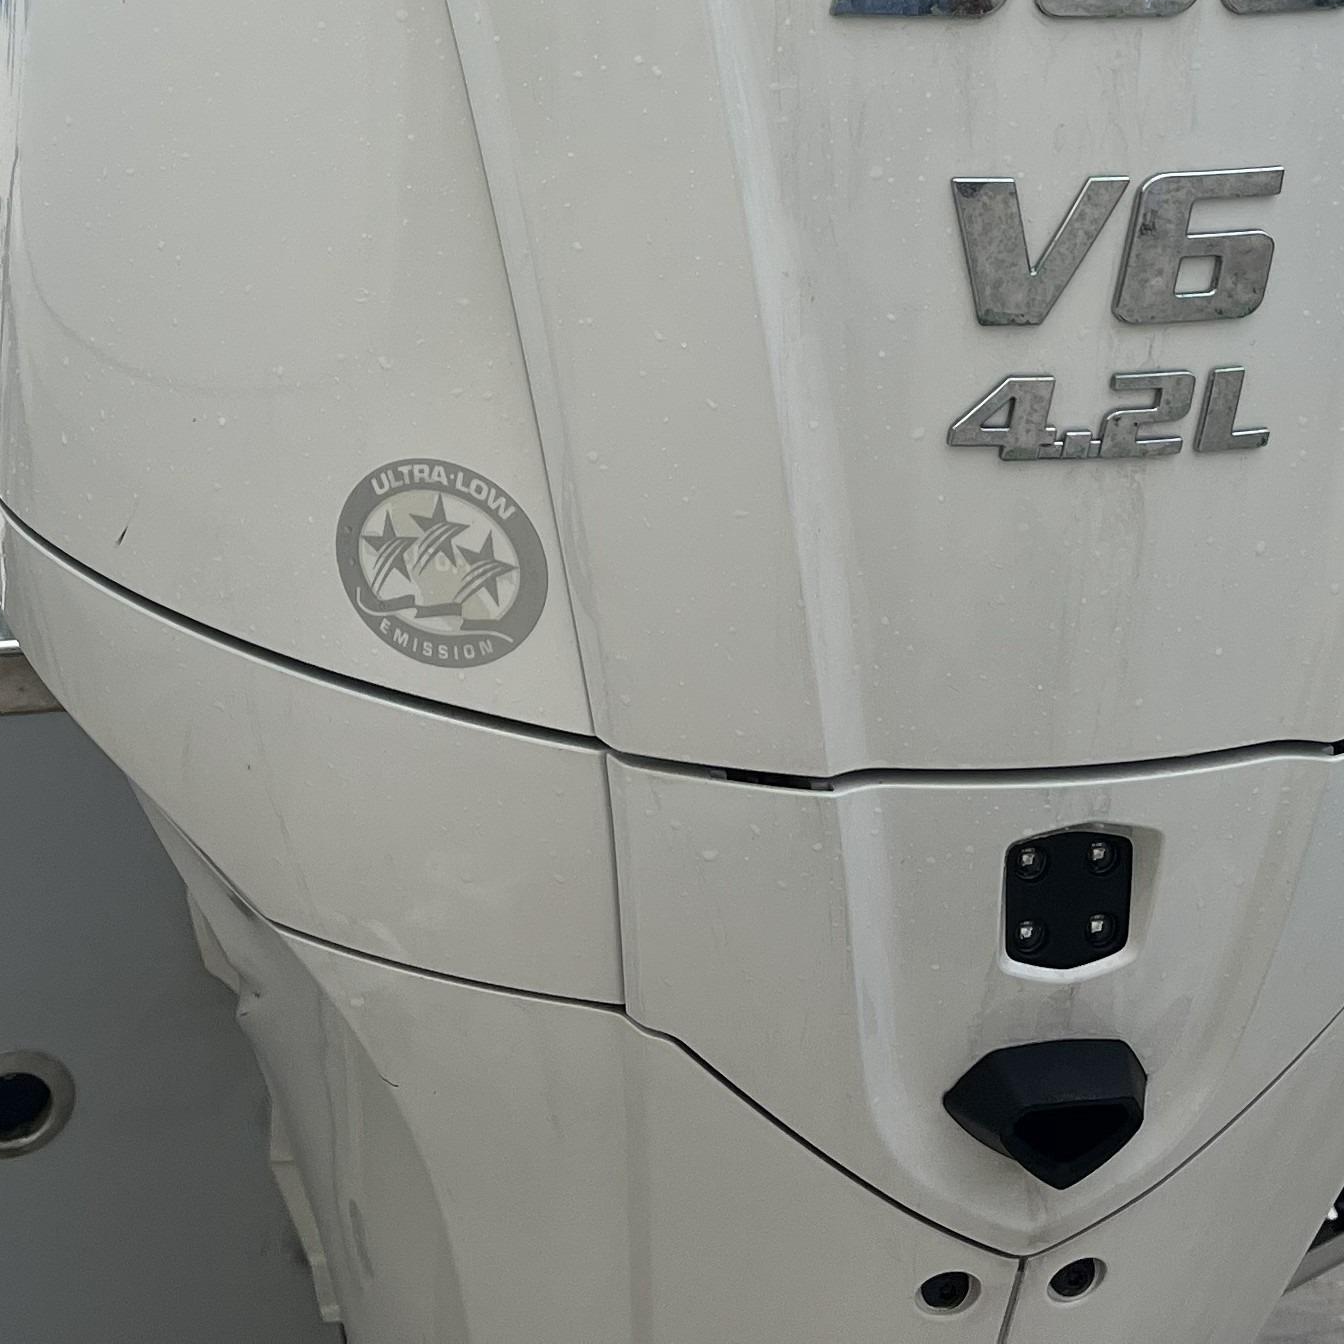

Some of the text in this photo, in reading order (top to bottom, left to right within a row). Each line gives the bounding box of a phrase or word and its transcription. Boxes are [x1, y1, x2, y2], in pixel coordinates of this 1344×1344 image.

[950, 165, 1286, 327] V6
[946, 363, 1271, 461] 4.2L
[379, 617, 495, 660] EMISSION
